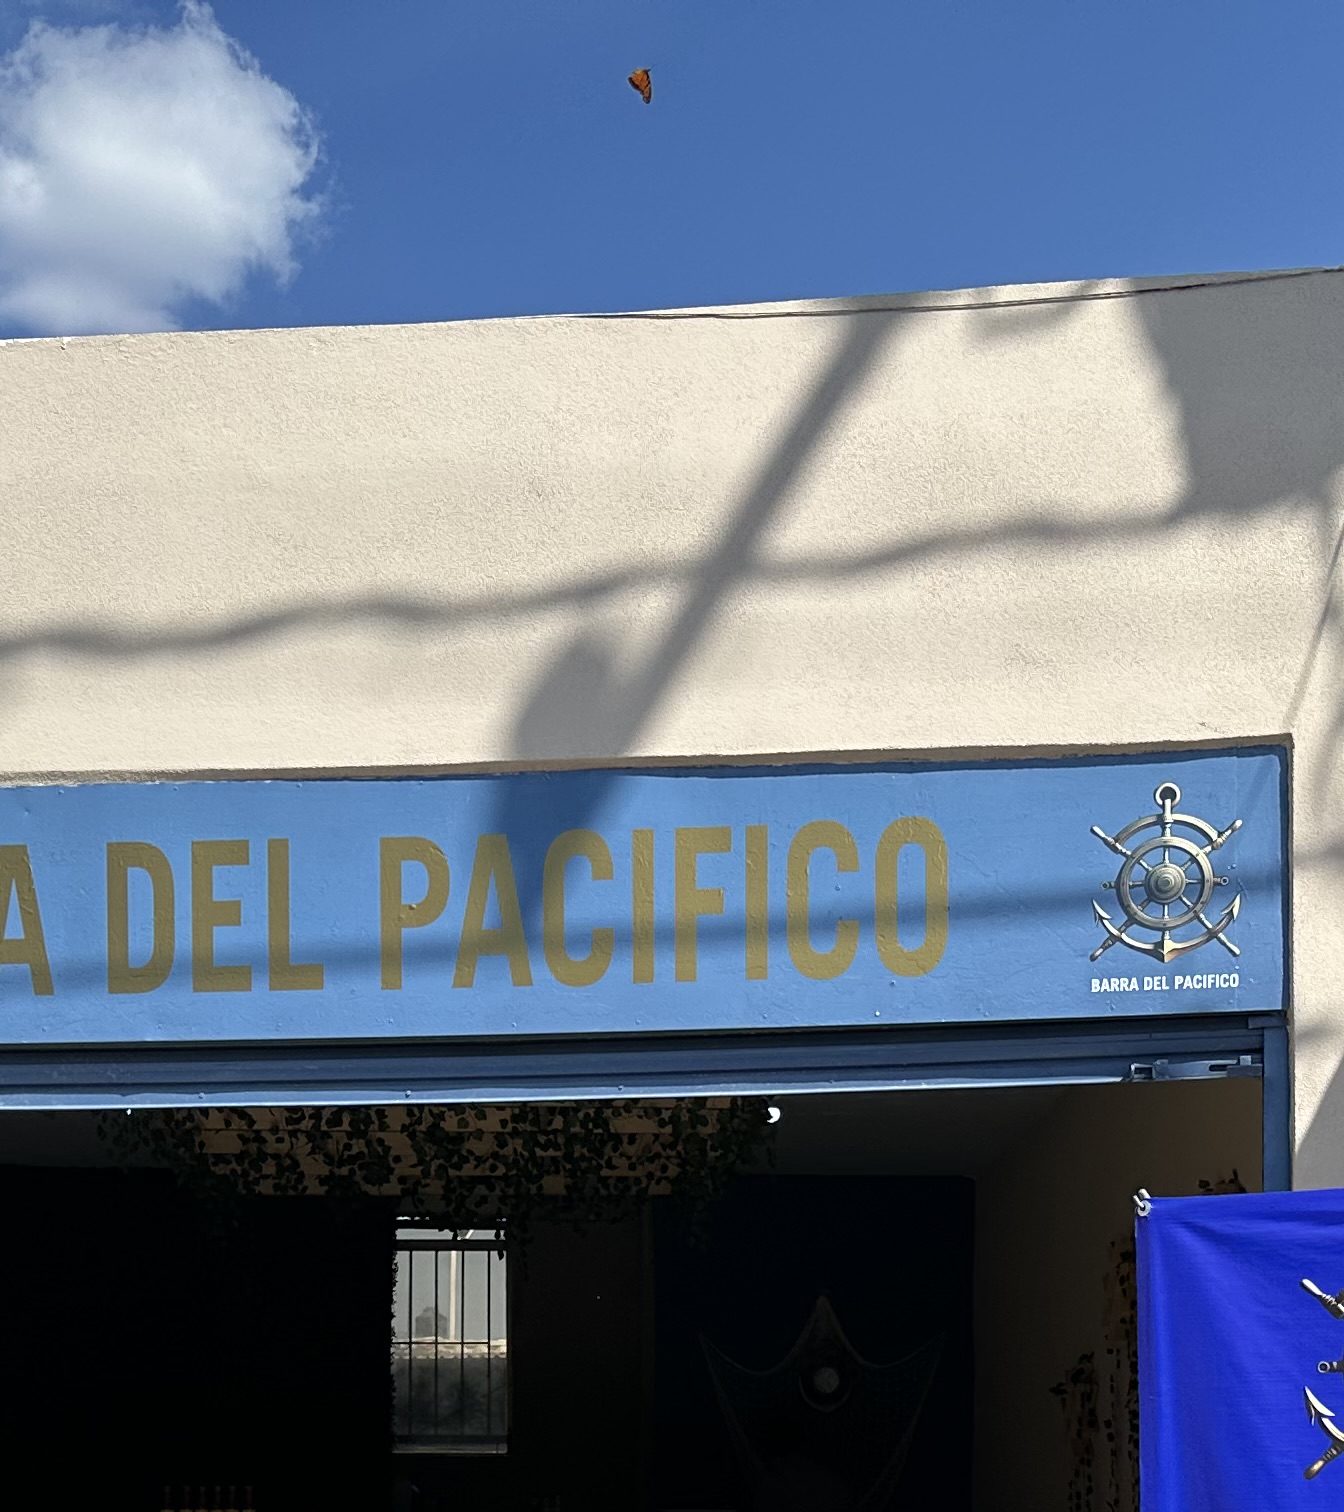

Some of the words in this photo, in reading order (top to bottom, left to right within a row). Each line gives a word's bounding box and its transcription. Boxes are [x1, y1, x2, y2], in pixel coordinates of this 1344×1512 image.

[106, 838, 324, 995] DEL
[378, 815, 949, 991] PACIFICO
[1091, 977, 1139, 993] BARRA
[1143, 976, 1170, 991] DEL
[1174, 973, 1239, 990] PACIFICO
